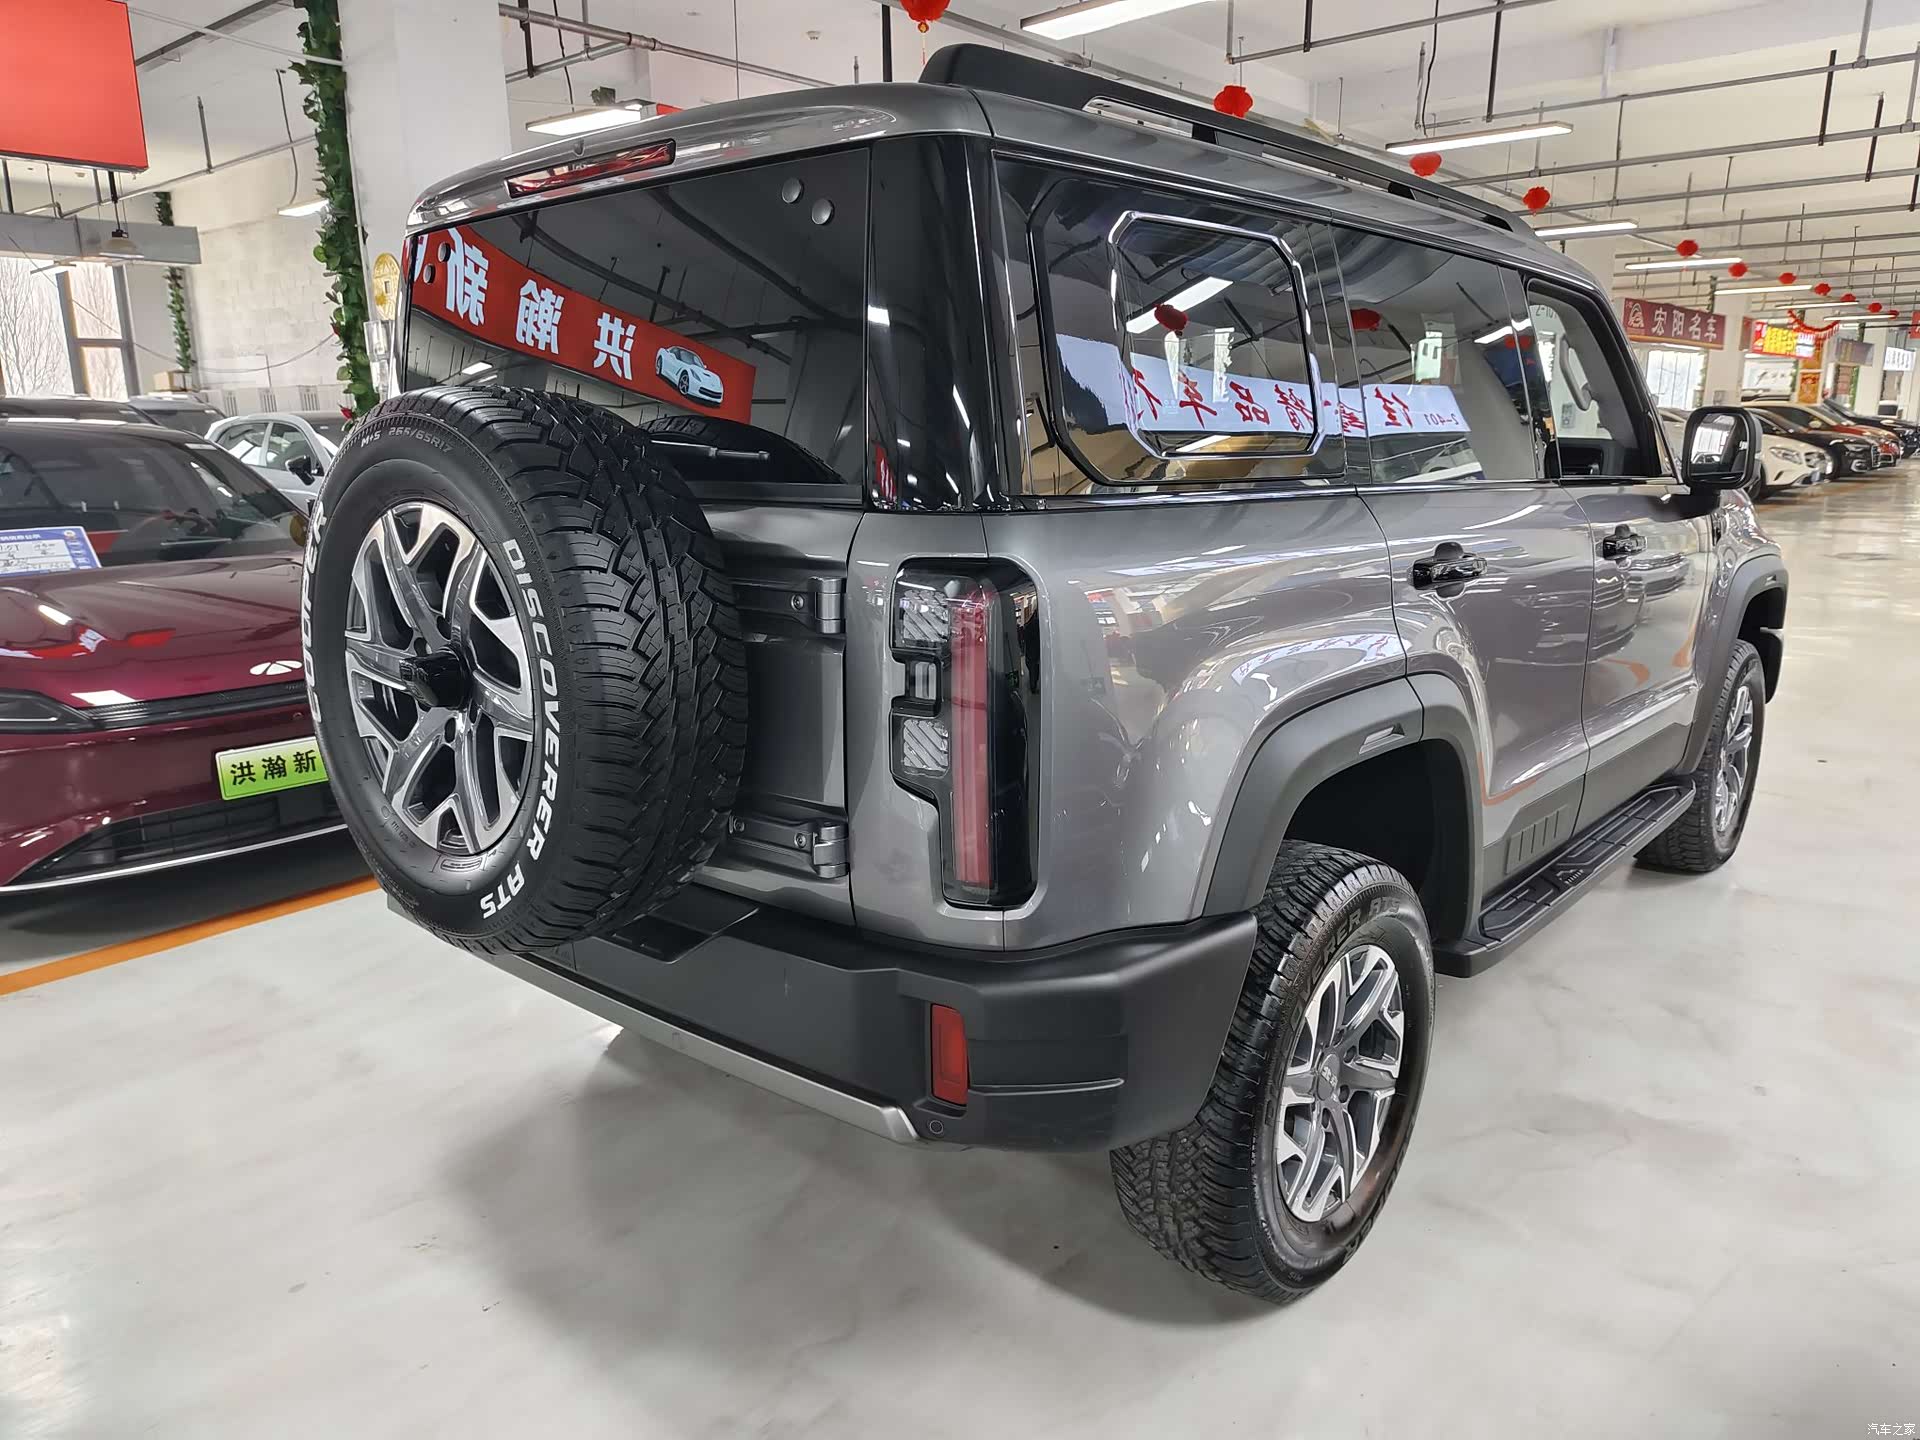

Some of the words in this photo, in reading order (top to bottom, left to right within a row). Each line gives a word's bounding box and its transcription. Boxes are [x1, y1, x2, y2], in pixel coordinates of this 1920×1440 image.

[1651, 306, 1717, 342] 宏阳名车
[502, 538, 561, 860] DISCOVERER
[230, 749, 317, 786] 洪瀚新
[480, 862, 526, 919] ATS
